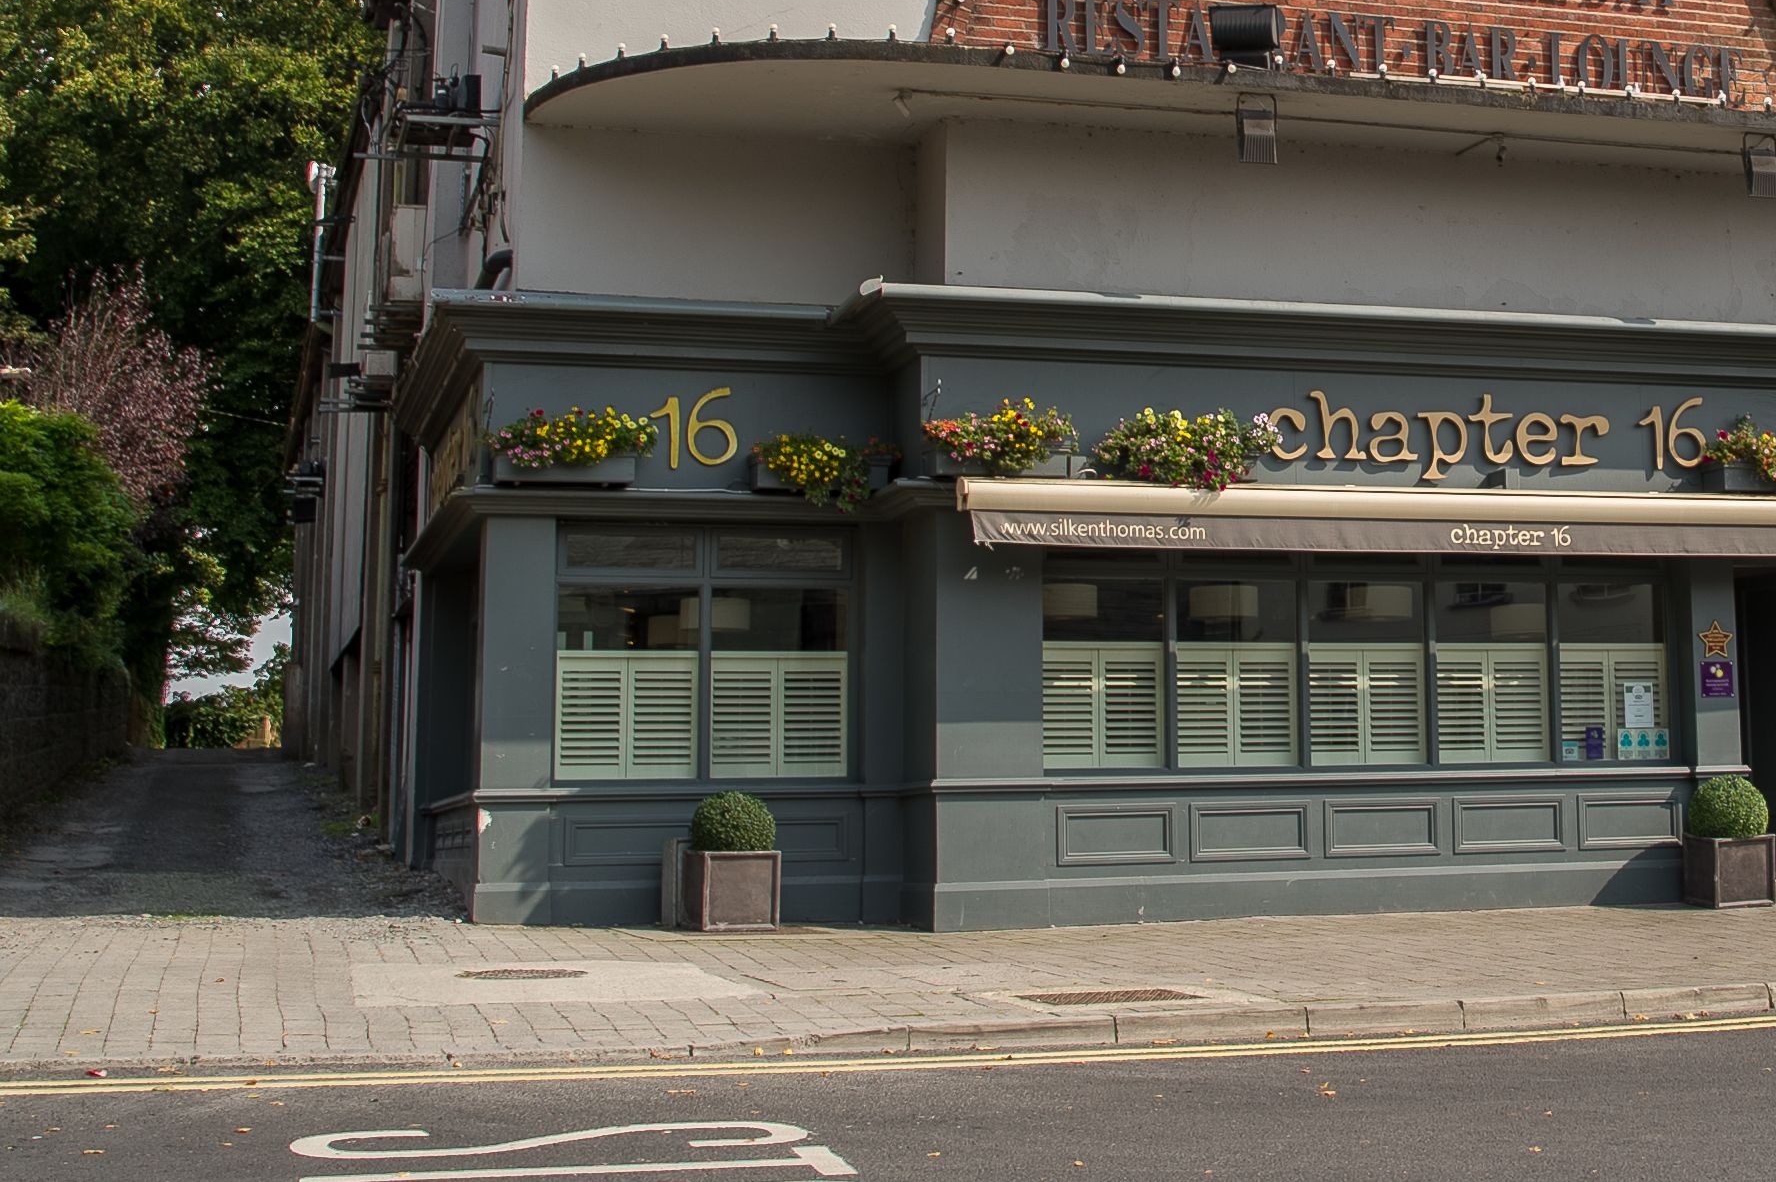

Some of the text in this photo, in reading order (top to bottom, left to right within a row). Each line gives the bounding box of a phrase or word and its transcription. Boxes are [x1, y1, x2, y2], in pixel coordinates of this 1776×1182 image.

[1424, 20, 1517, 81] BAR
[1549, 31, 1746, 106] LOUNGE
[650, 387, 738, 469] 16
[1271, 390, 1707, 480] chapter 16
[1000, 518, 1207, 540] www.silkenthomas.com
[1450, 524, 1572, 550] chapter 16
